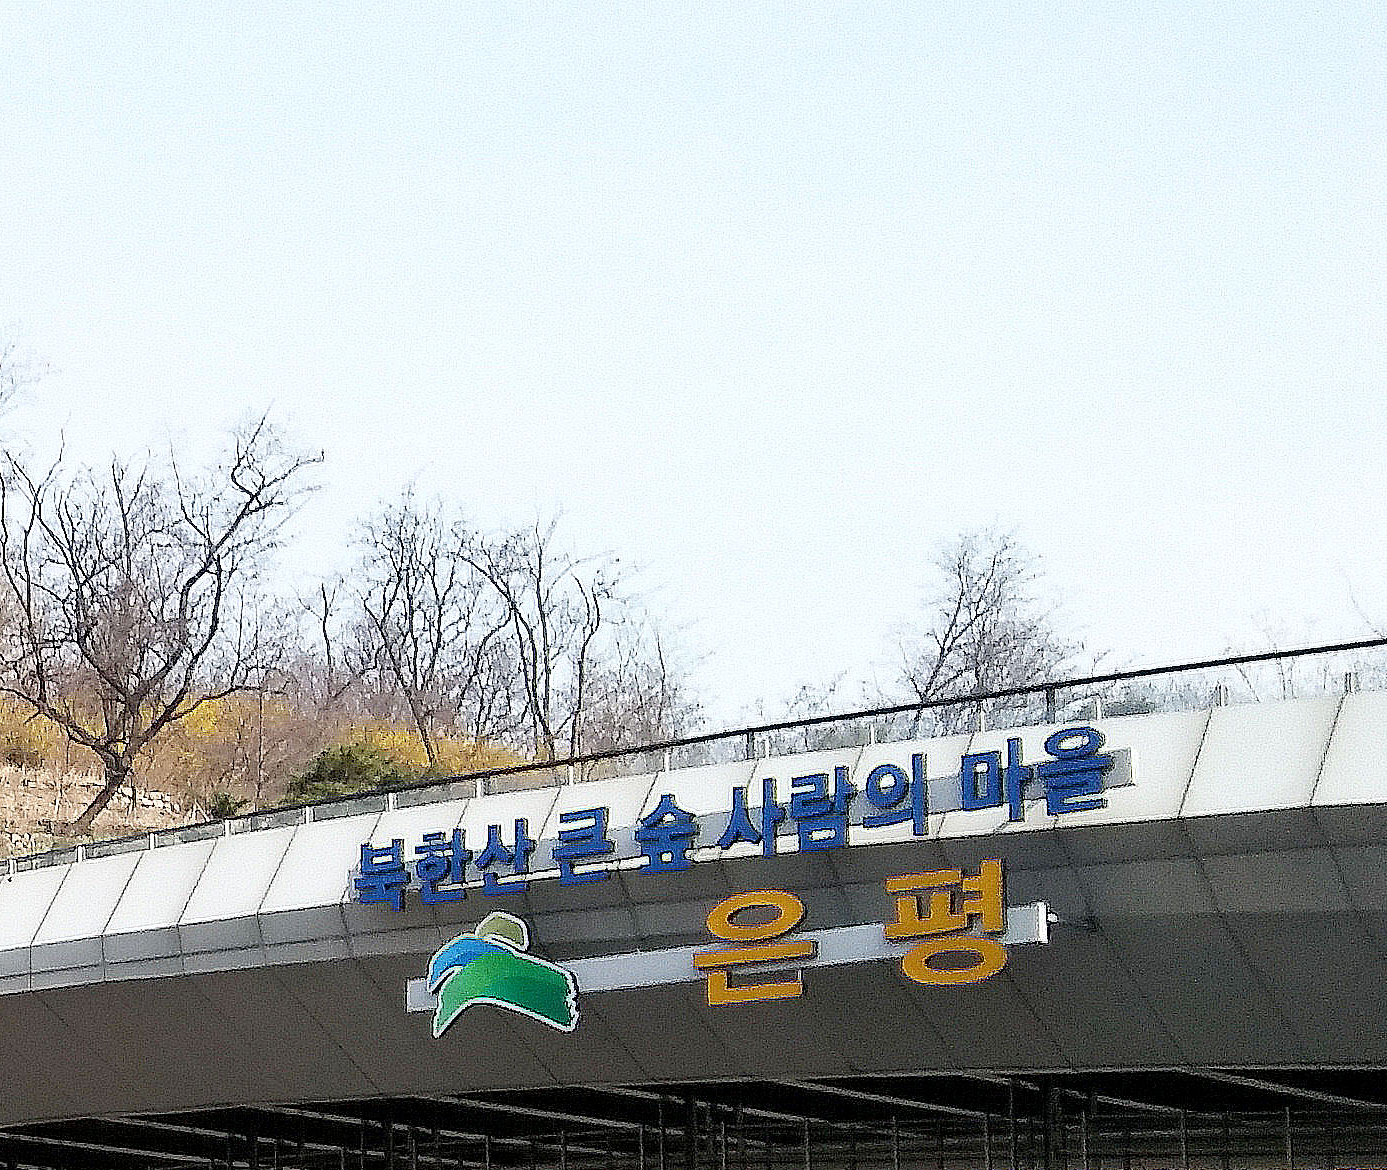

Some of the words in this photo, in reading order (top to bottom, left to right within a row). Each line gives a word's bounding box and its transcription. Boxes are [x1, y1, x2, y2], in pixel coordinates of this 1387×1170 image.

[354, 817, 533, 911] 북한산
[549, 805, 614, 886] 큰
[635, 794, 702, 873] 숲
[717, 753, 930, 857] 사람의
[961, 725, 1118, 822] 마을
[692, 857, 1009, 1006] 은평
